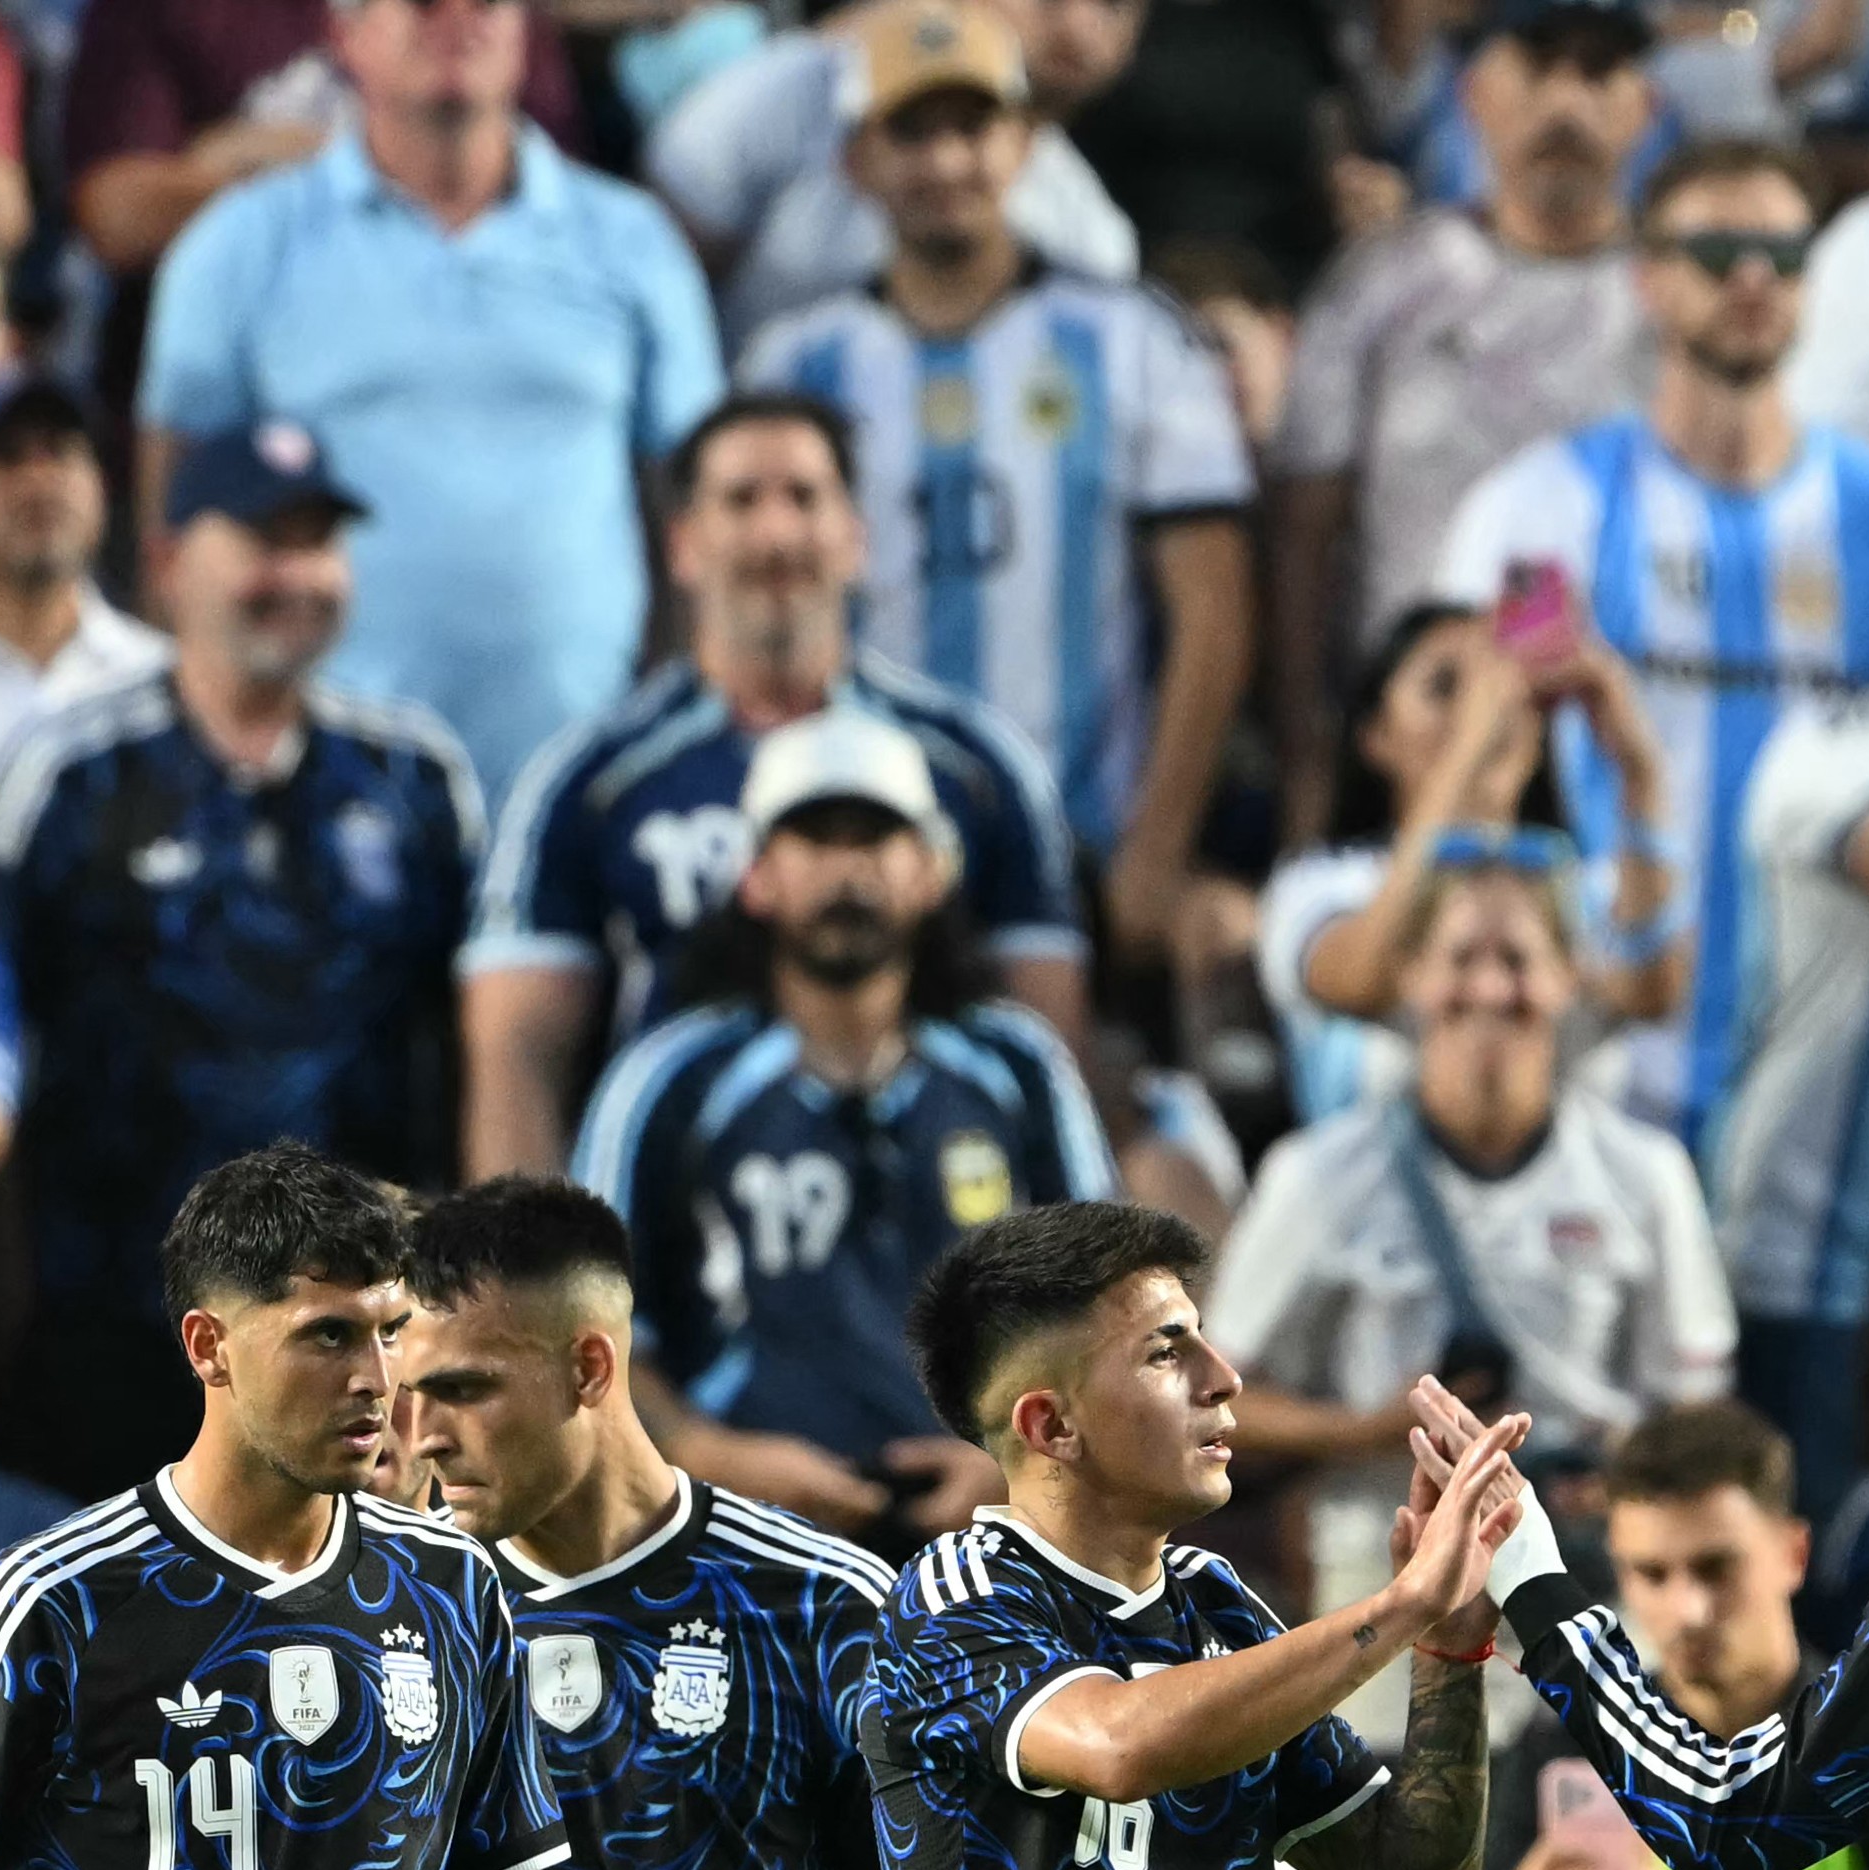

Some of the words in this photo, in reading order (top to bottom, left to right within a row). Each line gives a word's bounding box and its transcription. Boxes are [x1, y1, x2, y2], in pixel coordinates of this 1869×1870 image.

[732, 1150, 852, 1278] 19
[397, 1676, 427, 1716] AFA
[552, 1695, 582, 1706] FIFA
[669, 1670, 711, 1710] AFA
[292, 1708, 321, 1719] FIFA
